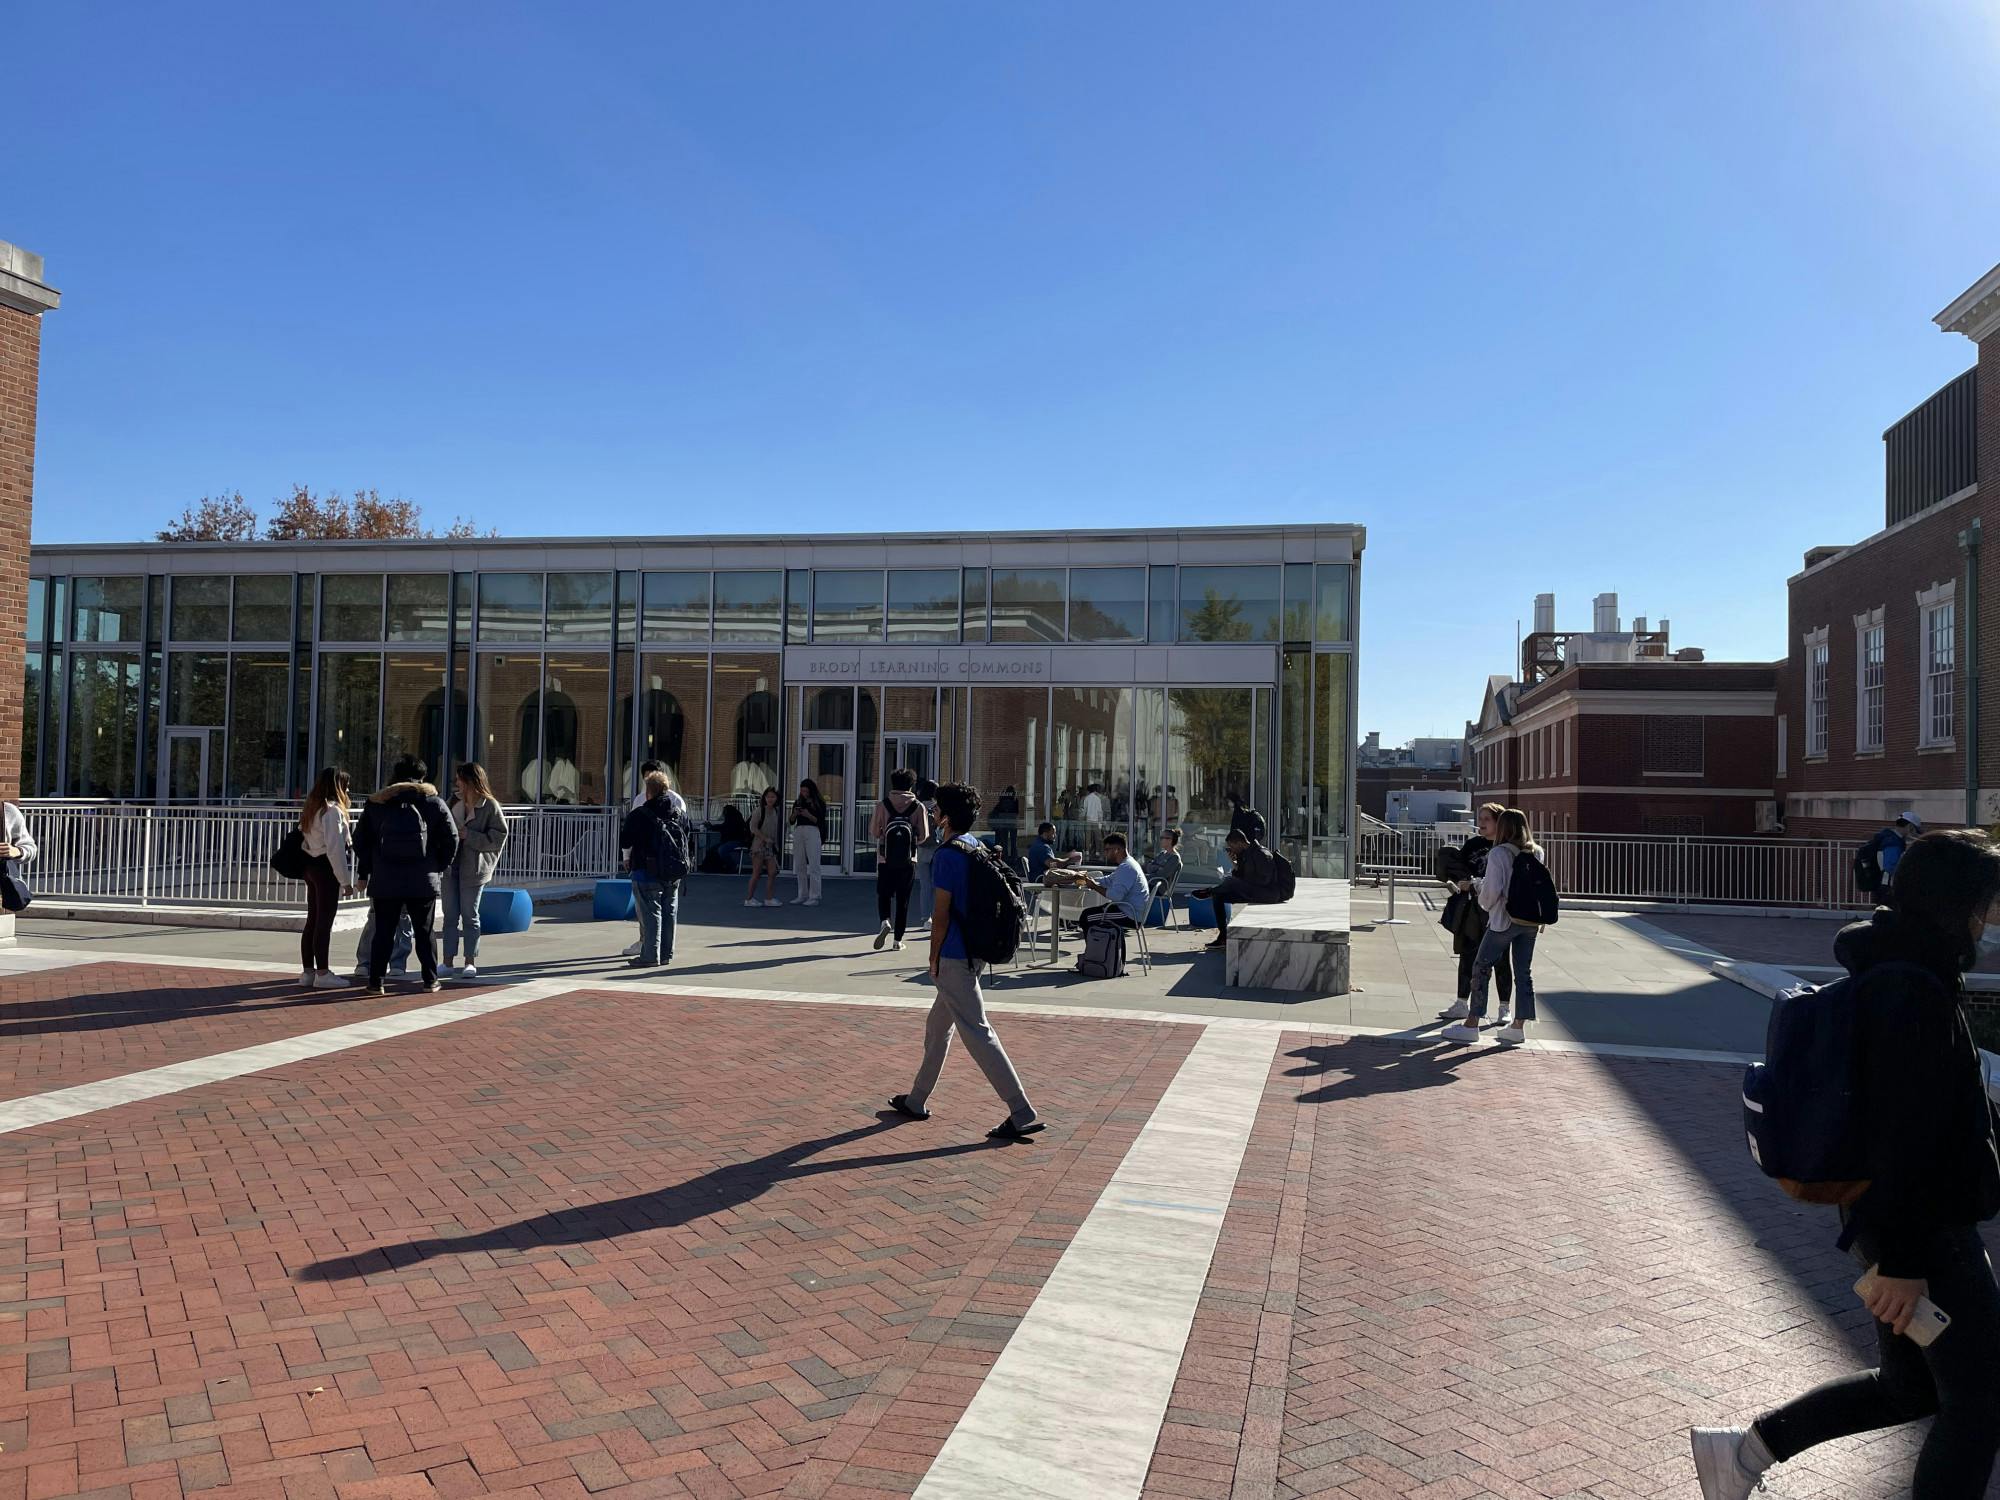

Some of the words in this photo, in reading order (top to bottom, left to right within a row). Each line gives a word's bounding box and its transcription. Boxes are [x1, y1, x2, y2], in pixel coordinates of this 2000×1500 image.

[809, 661, 860, 674] BRODY
[870, 661, 950, 674] LEARNING
[958, 661, 1043, 674] COMMONS
